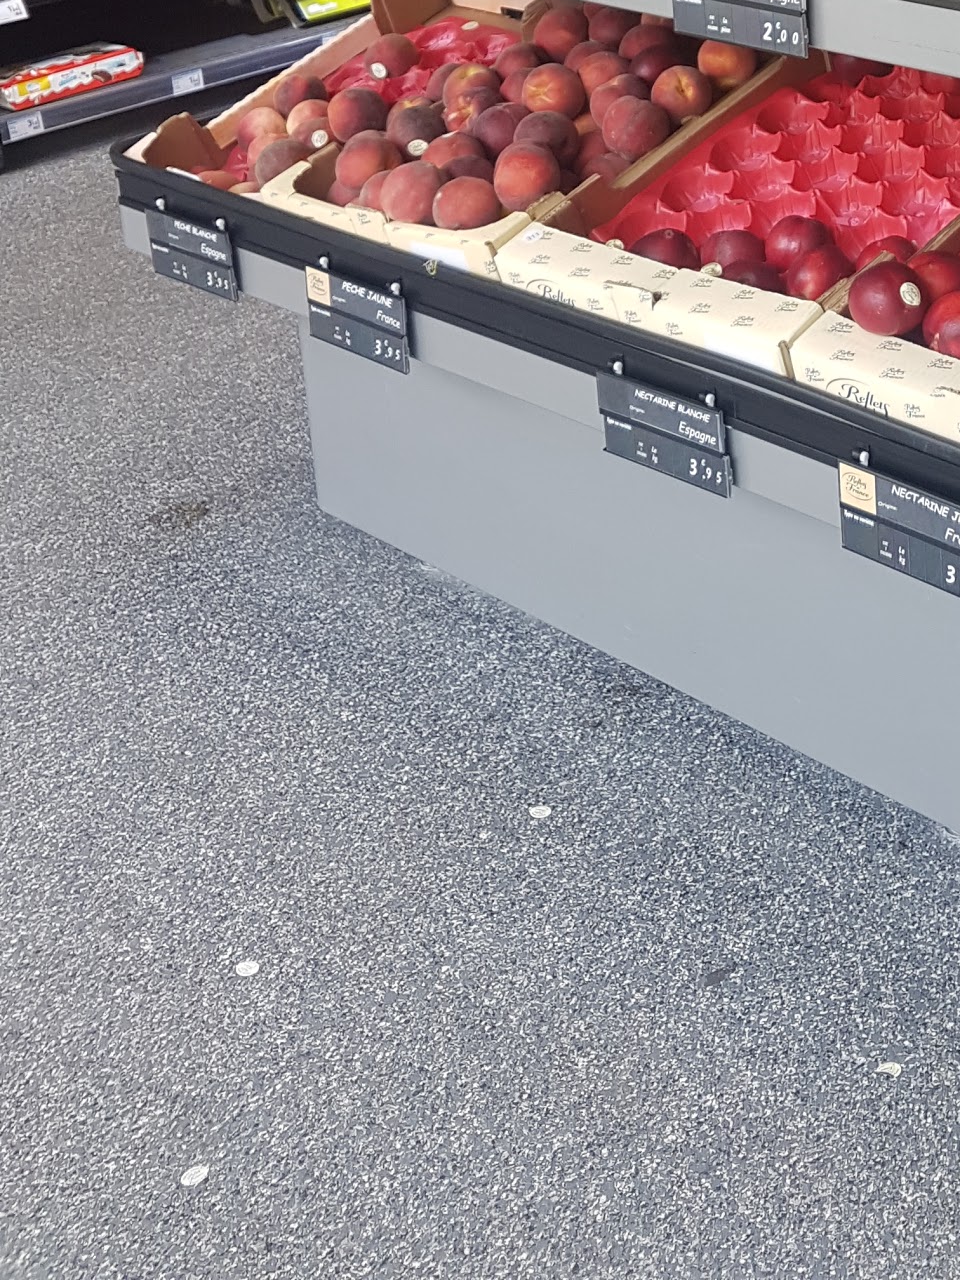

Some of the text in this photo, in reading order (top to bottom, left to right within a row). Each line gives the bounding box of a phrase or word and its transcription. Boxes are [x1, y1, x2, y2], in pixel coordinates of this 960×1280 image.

[201, 243, 227, 261] Espagne
[342, 281, 393, 308] PECHE JAUNE
[376, 310, 401, 329] France
[634, 389, 711, 423] NECTARINE BLANCHE
[838, 383, 890, 418] Reflets
[679, 421, 717, 445] Espagne
[891, 484, 950, 518] NECTARINE
